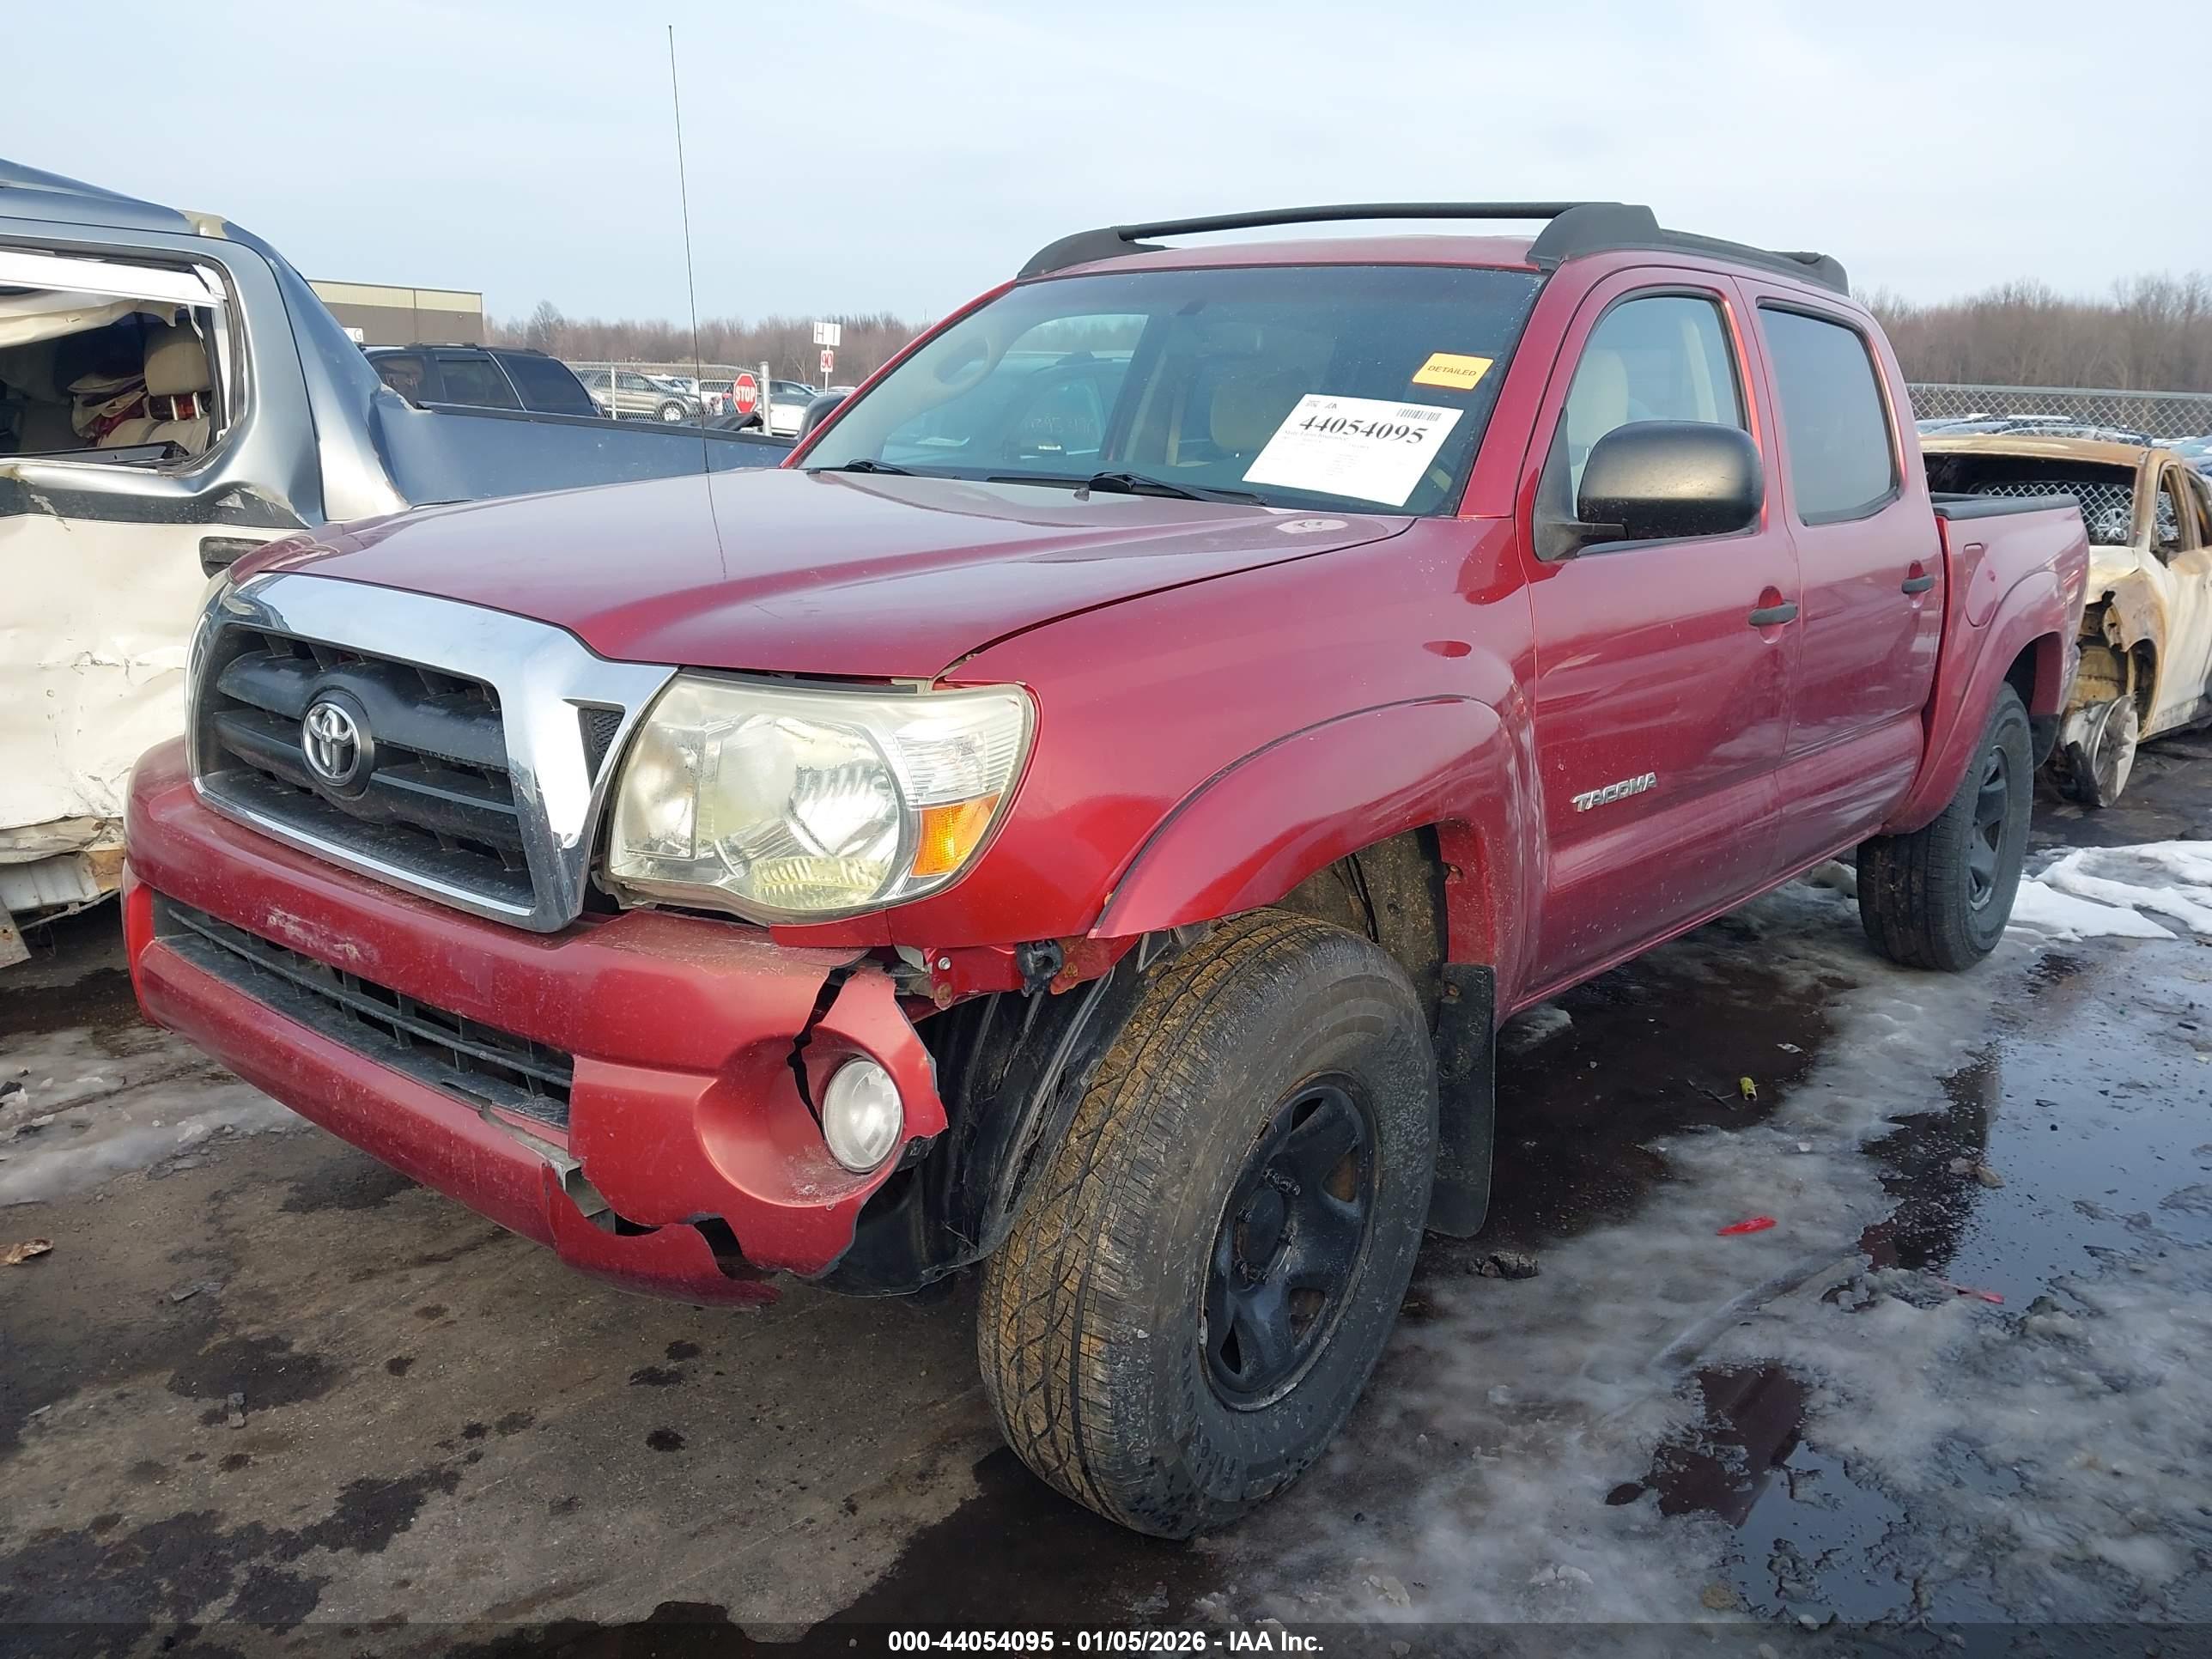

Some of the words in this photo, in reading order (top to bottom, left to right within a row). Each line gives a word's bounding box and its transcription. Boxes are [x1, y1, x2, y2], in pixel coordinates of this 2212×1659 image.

[816, 323, 824, 343] H
[821, 353, 833, 368] 90
[1427, 365, 1477, 377] DETAILED
[735, 386, 756, 403] STOP
[1299, 415, 1429, 444] 44054095
[1571, 772, 1657, 812] TACOMA
